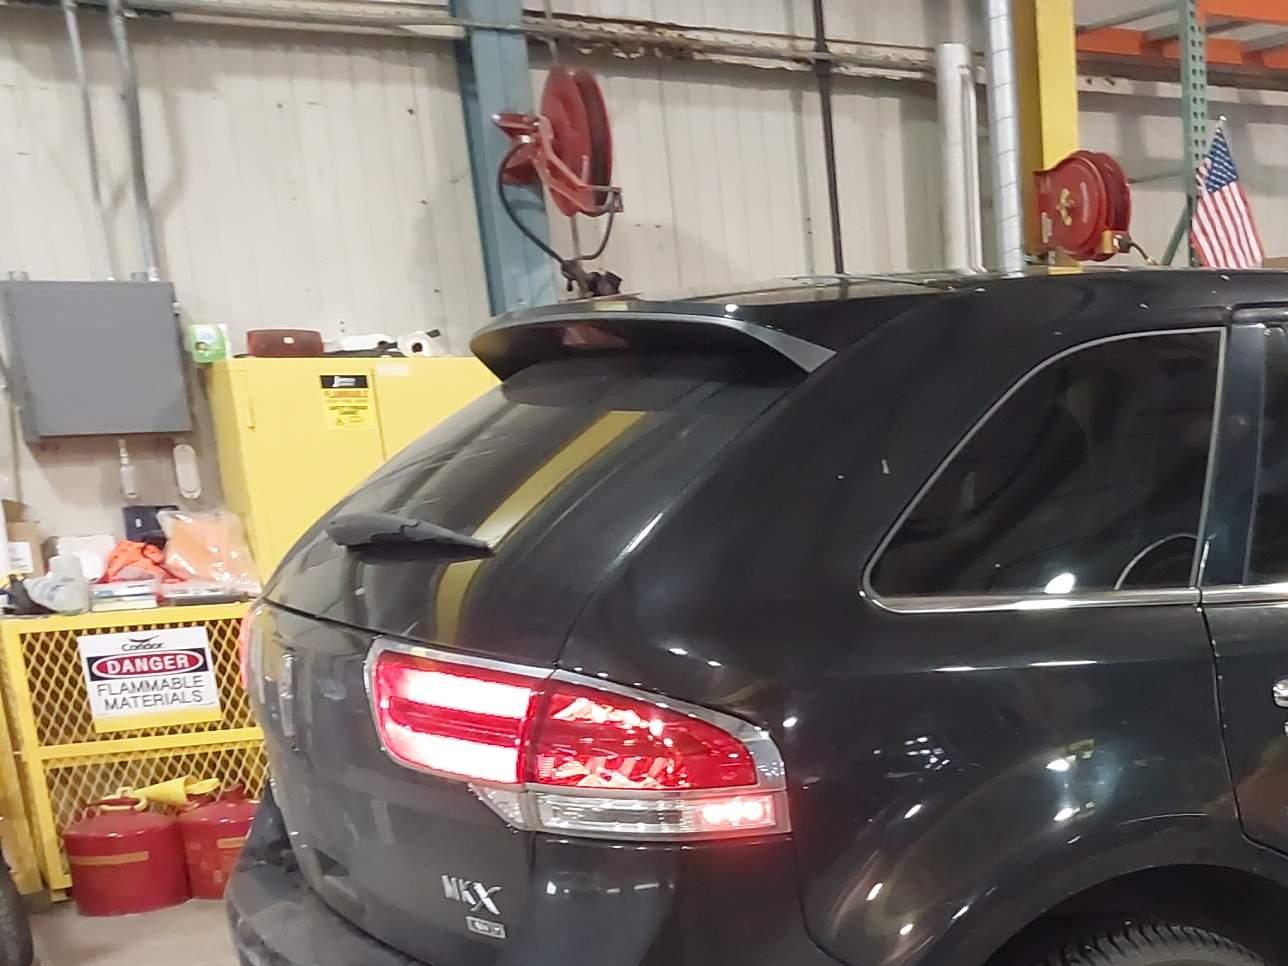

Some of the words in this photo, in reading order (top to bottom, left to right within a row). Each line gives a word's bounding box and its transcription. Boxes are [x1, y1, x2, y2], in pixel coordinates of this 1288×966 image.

[106, 654, 190, 674] DANGER
[97, 675, 204, 696] FLAMMABLE
[104, 690, 203, 711] MATERIALS
